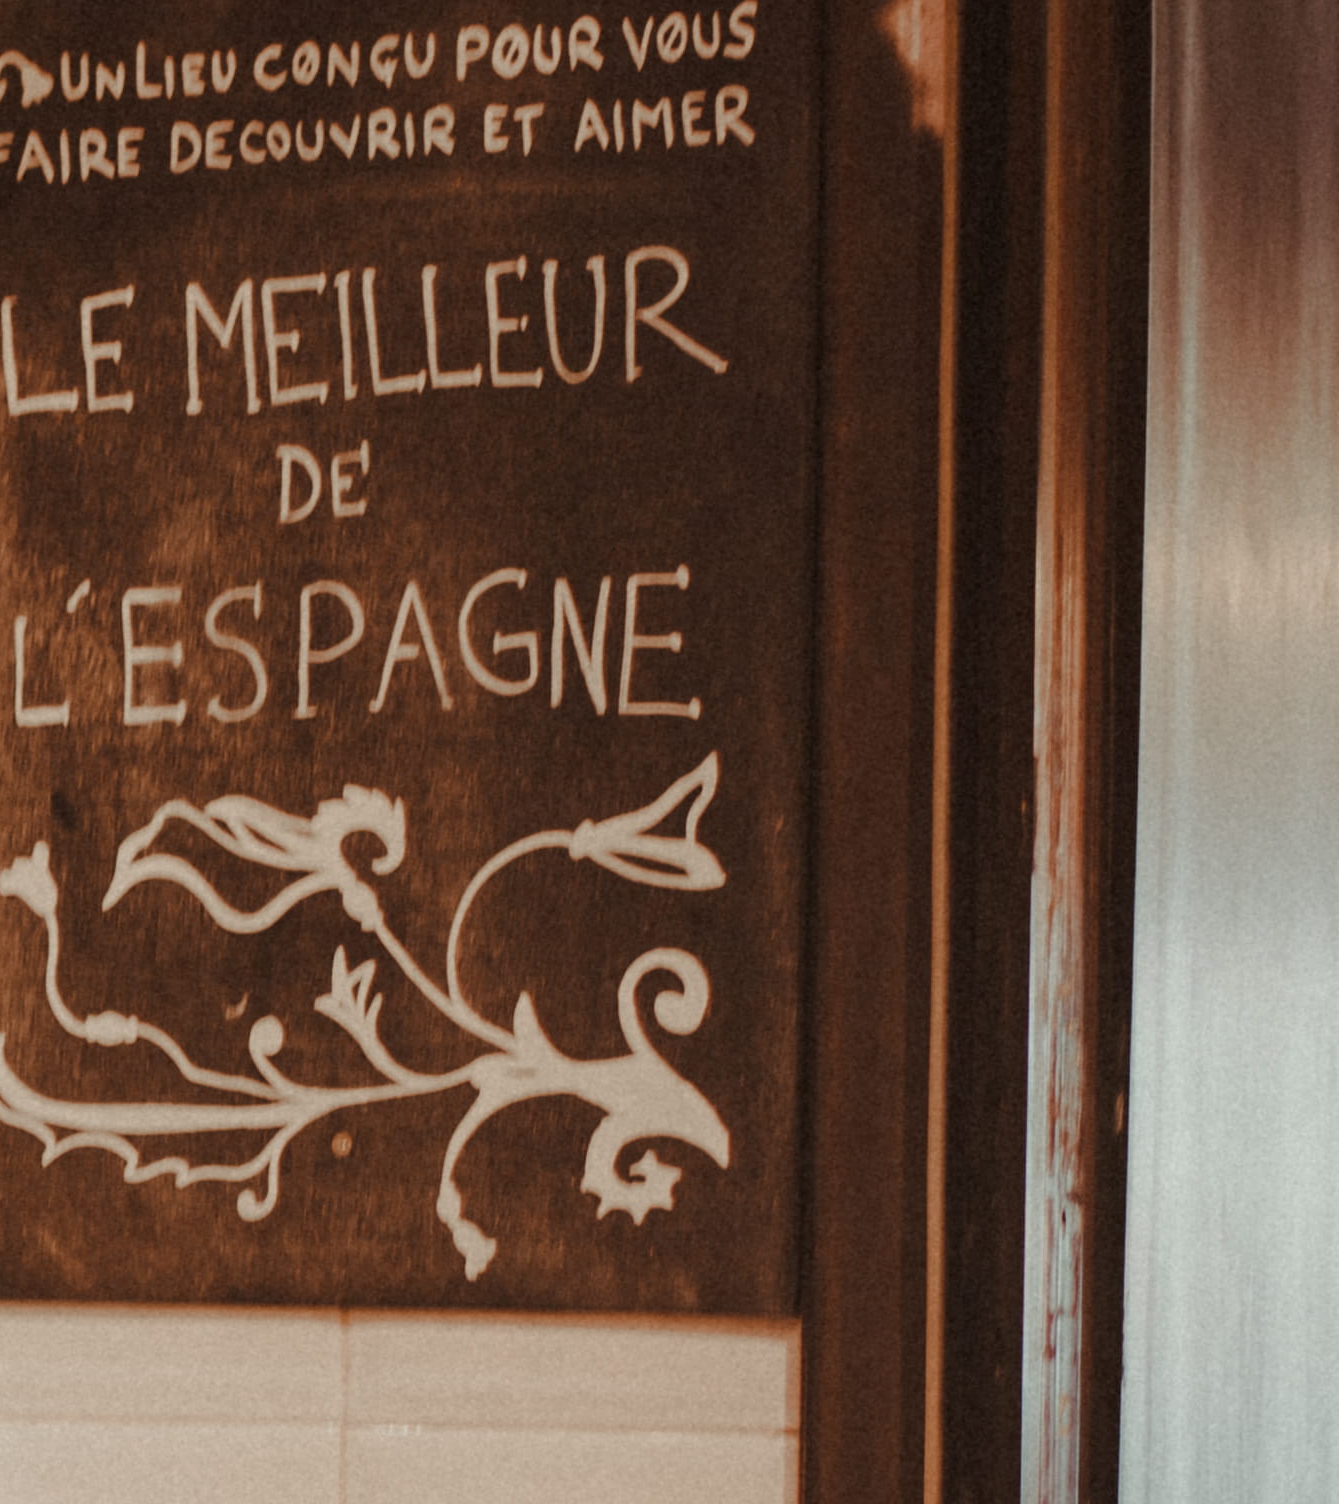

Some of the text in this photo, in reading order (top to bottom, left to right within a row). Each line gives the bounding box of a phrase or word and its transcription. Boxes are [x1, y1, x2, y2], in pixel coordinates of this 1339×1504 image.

[134, 41, 238, 100] LIEU
[168, 103, 456, 174] DECOUVRIR
[482, 102, 545, 157] ET
[573, 84, 756, 153] AIMER
[183, 245, 729, 417] MEILLEUR
[275, 439, 371, 525] DE
[10, 564, 702, 733] L'ESPAGNE
